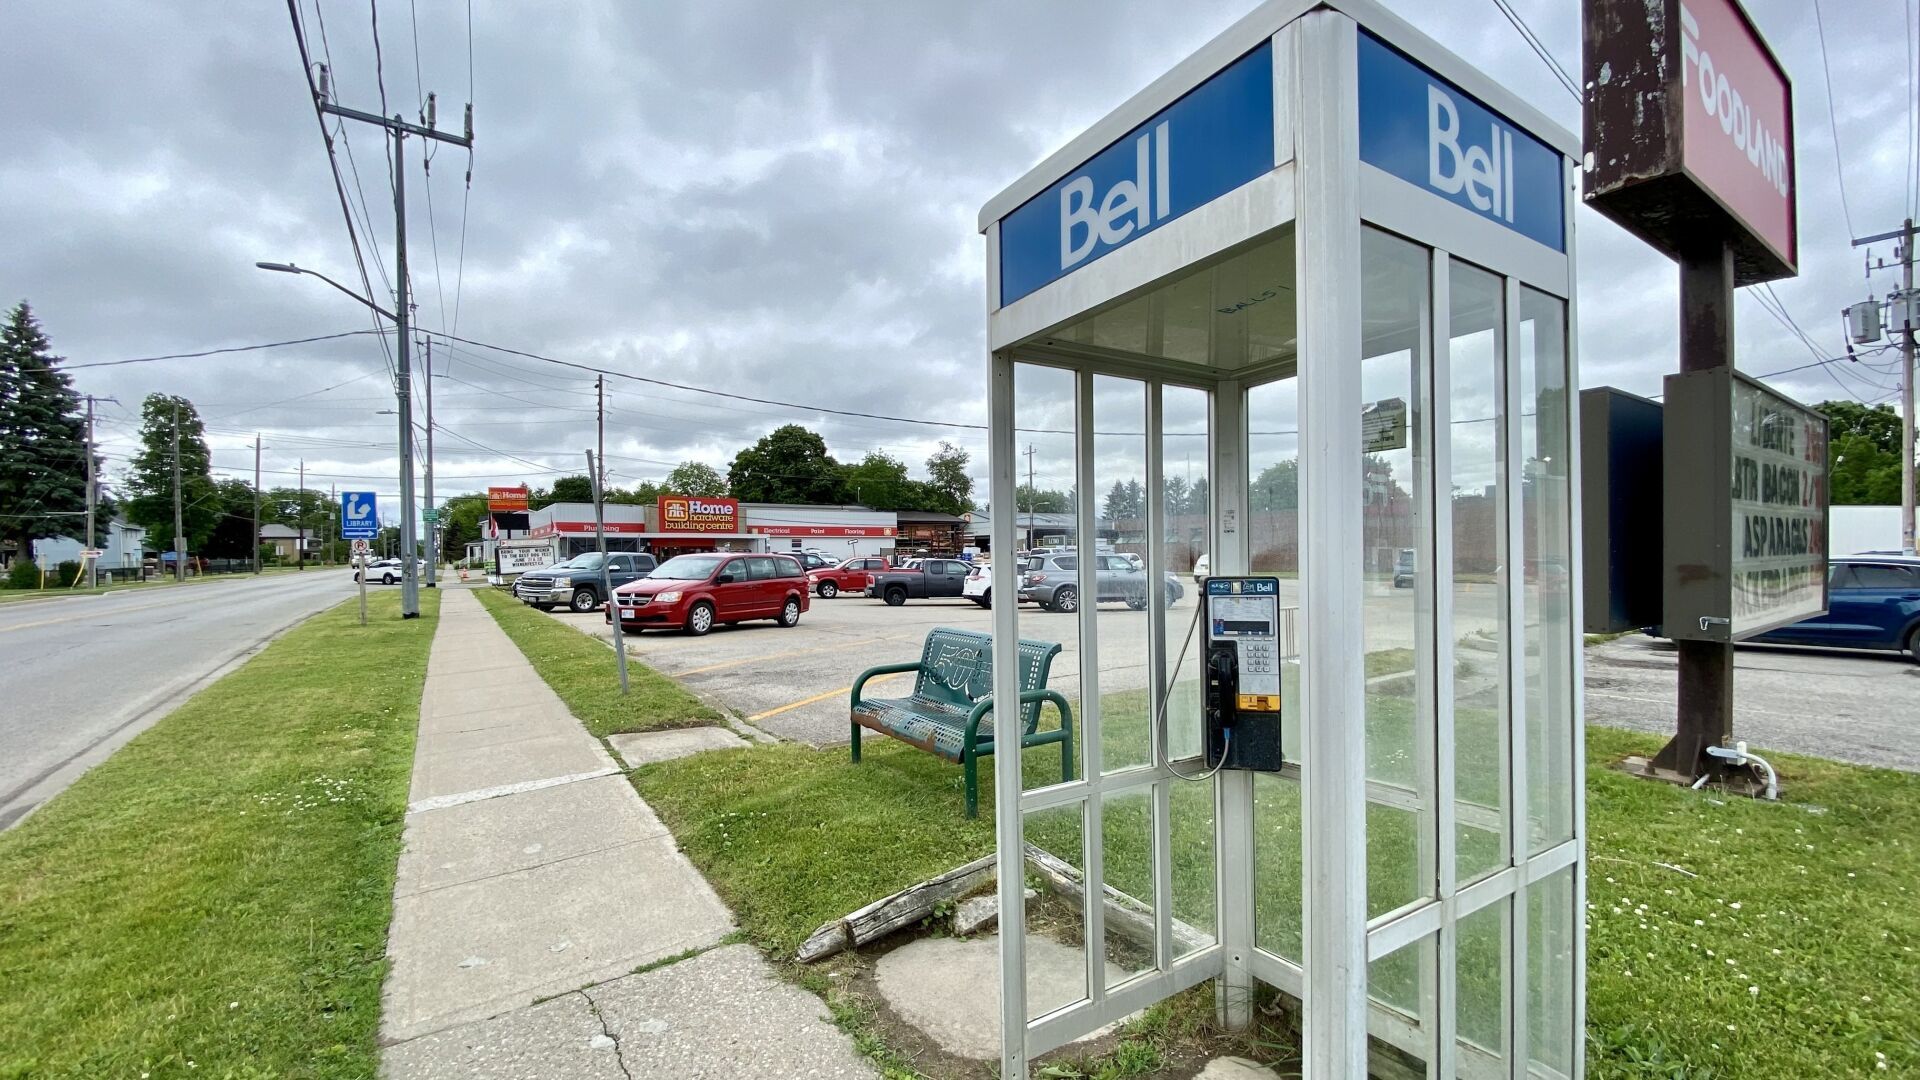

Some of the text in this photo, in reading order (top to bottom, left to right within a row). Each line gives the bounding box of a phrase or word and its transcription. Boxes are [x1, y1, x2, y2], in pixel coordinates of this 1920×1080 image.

[1681, 2, 1789, 198] FOODLAND
[1427, 83, 1514, 224] Bell
[1060, 119, 1170, 270] Bell
[1762, 463, 1800, 506] BACON
[502, 491, 527, 499] Home
[689, 501, 734, 515] Home
[690, 512, 734, 521] hardware
[583, 524, 620, 533] Plubing
[665, 521, 734, 532] building centre
[844, 528, 866, 536] Flooring
[1257, 583, 1273, 592] Bell
